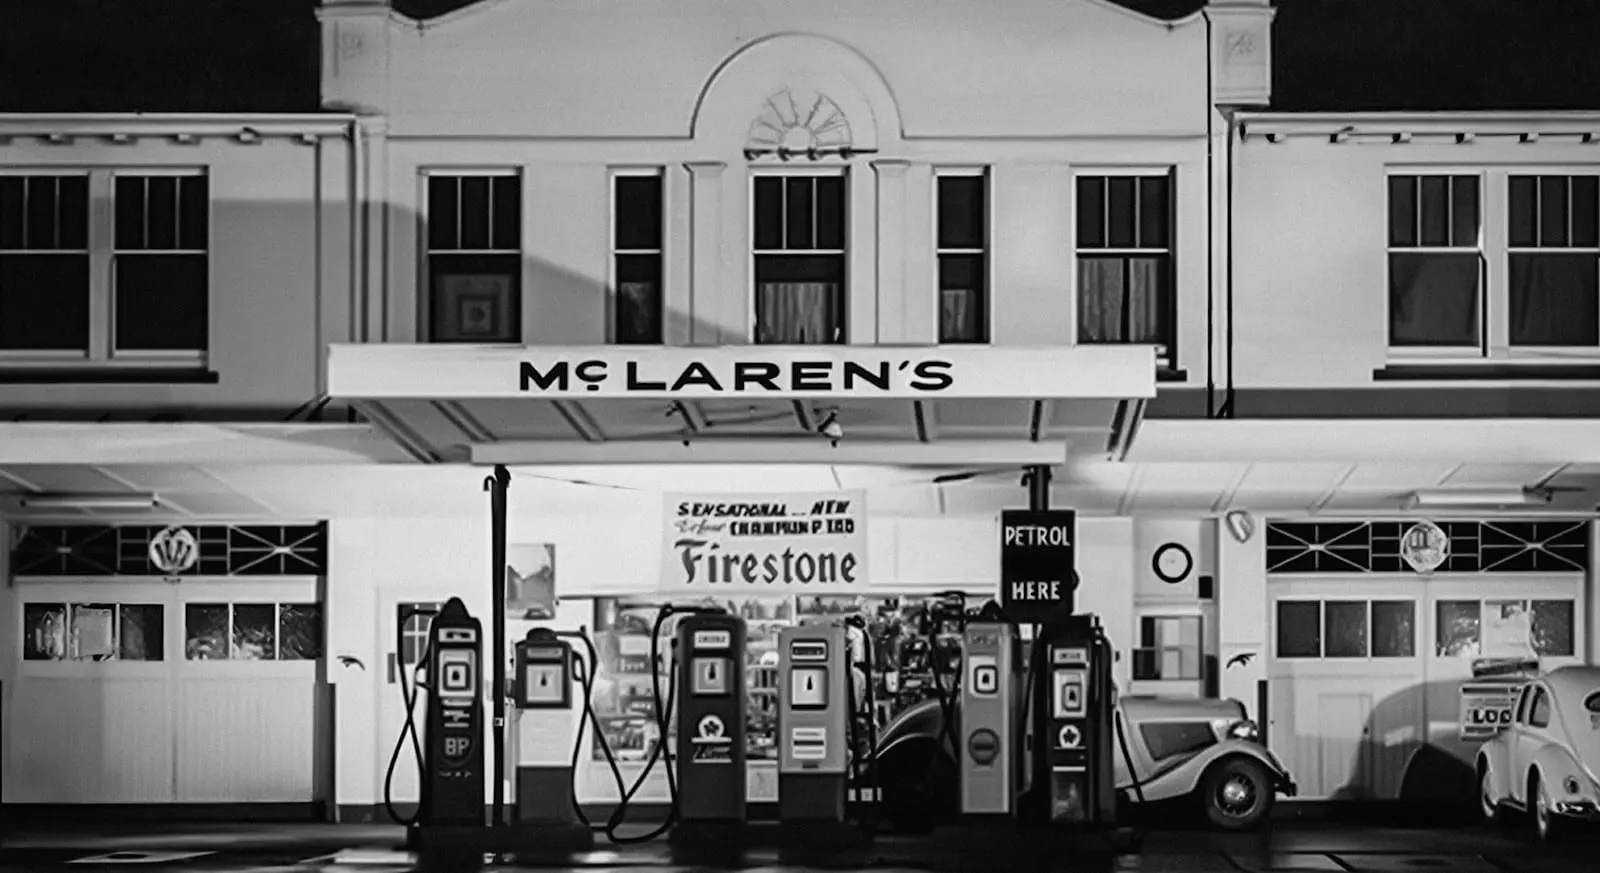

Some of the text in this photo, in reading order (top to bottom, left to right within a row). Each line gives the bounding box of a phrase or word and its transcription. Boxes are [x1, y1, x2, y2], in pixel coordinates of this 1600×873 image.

[677, 499, 850, 517] SENSATIONAL NEW
[1005, 526, 1071, 546] PETROL
[674, 538, 857, 584] Firestone
[1012, 581, 1061, 600] HERE
[444, 737, 470, 756] BP
